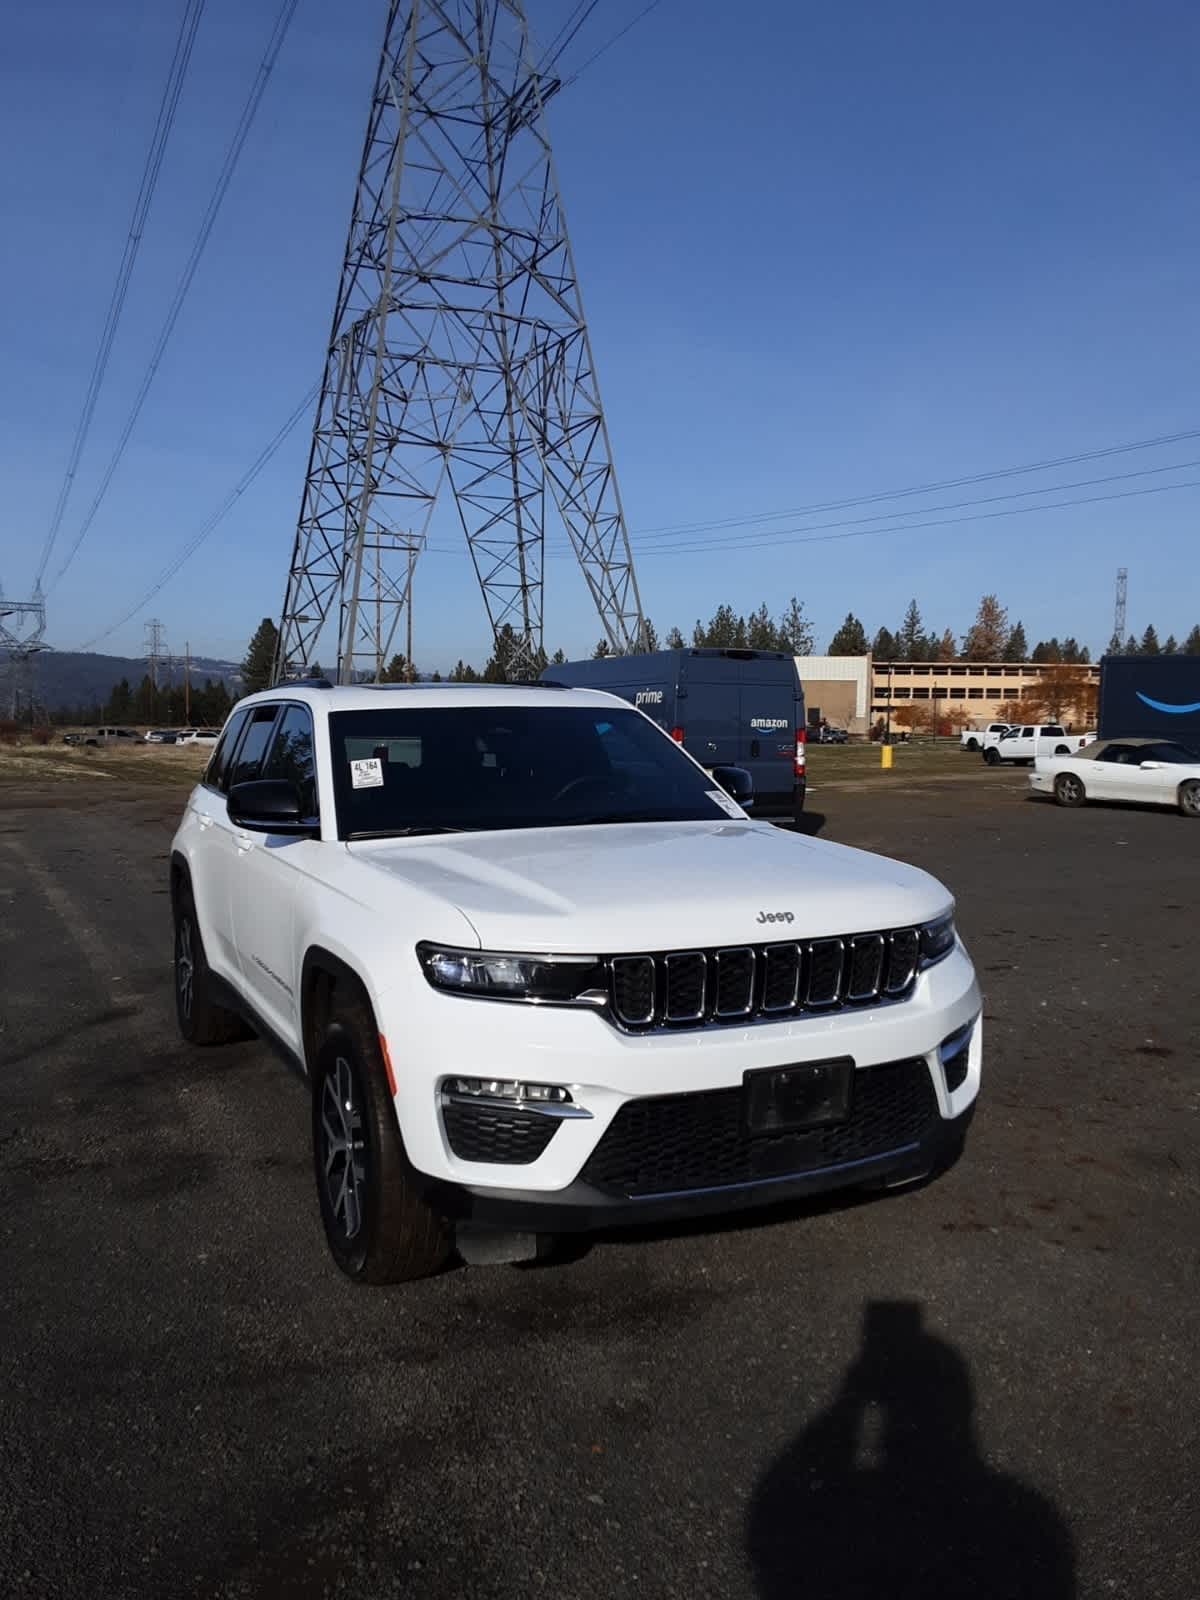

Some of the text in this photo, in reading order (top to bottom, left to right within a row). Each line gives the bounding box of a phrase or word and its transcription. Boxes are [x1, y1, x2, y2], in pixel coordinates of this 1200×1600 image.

[635, 688, 663, 707] prime
[750, 718, 788, 728] amazon
[756, 911, 794, 924] Jeep
